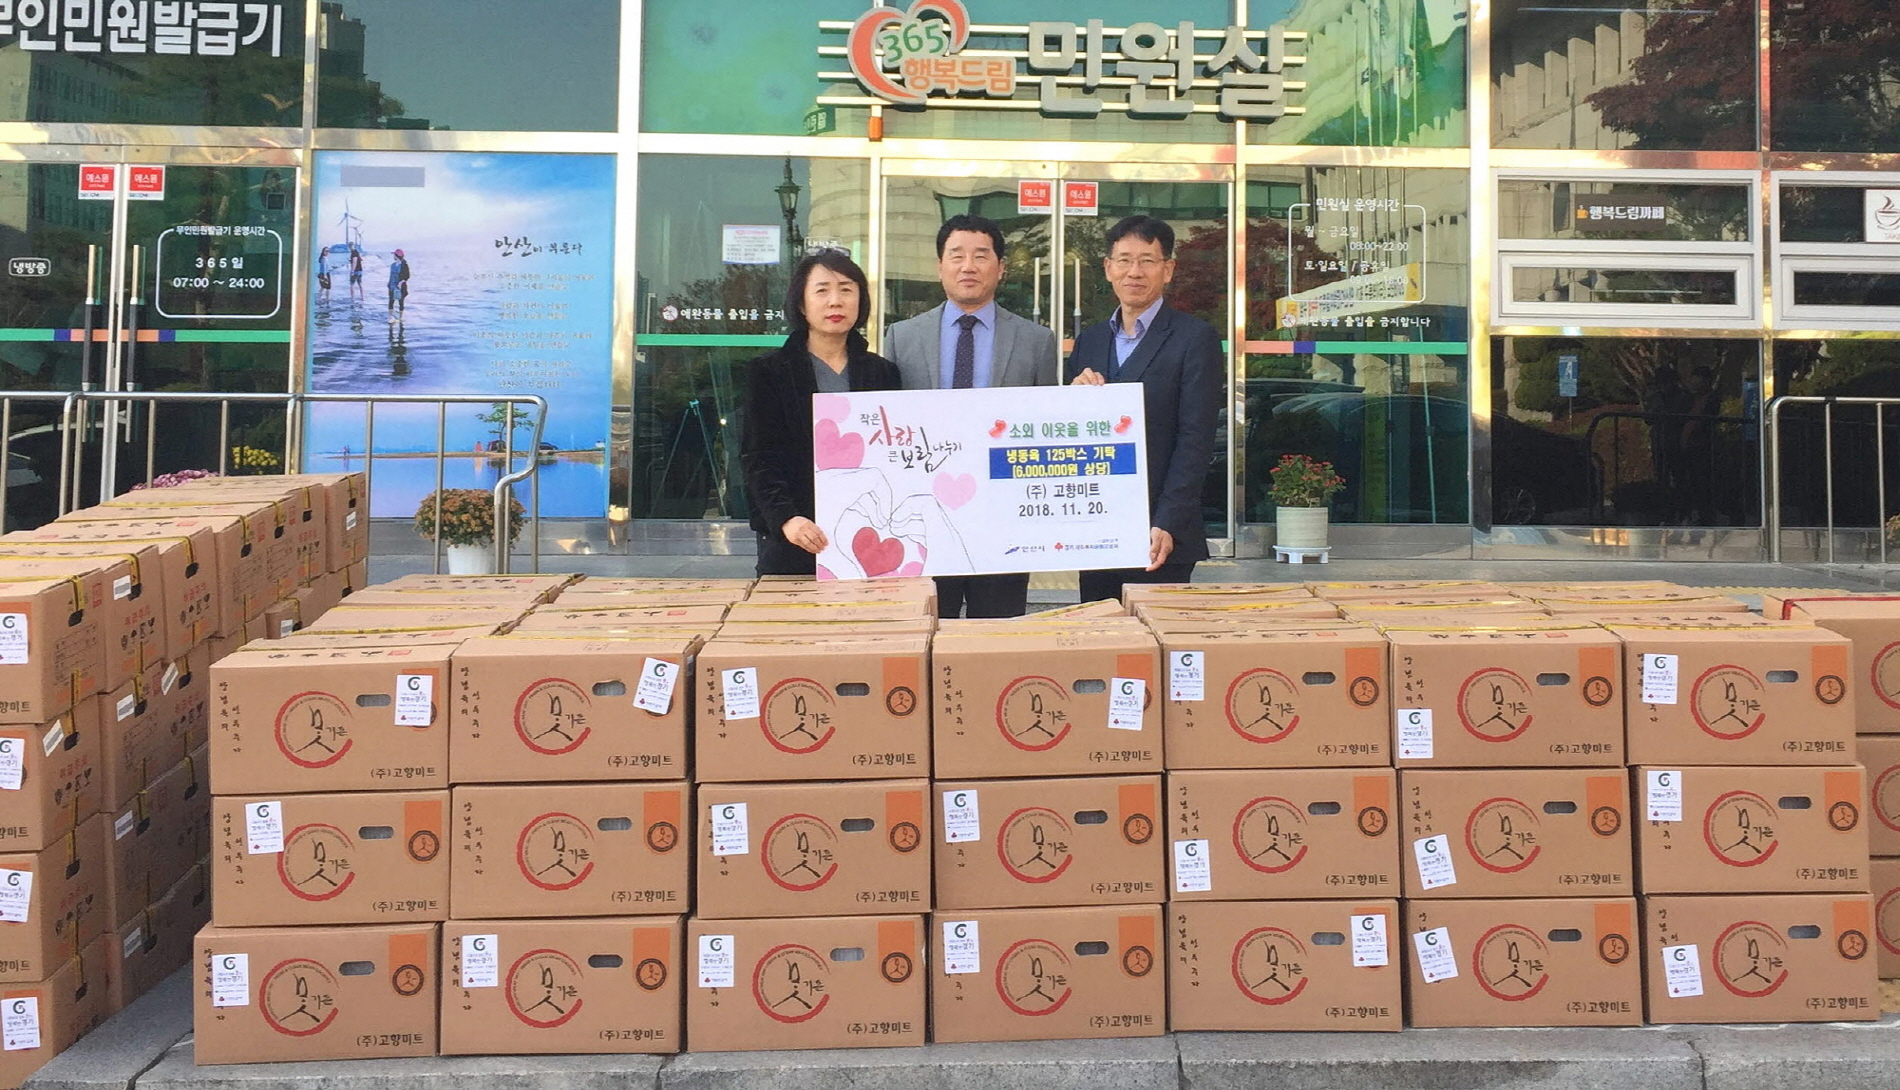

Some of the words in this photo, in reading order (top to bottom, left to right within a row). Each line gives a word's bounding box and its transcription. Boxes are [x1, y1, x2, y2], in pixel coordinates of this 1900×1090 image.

[881, 21, 946, 62] 365
[903, 57, 1012, 93] 행복드림
[1028, 19, 1284, 118] 민원실
[1316, 198, 1350, 211] 민원실
[1354, 199, 1399, 212] 운영시간
[1589, 205, 1665, 220] 행복드림까페
[234, 226, 265, 236] 운영시간
[1328, 226, 1359, 238] 금요일
[173, 277, 209, 288] 07:00
[229, 277, 265, 288] 24:00
[680, 308, 724, 321] 애완동물
[727, 308, 759, 320] 출입을
[1344, 316, 1375, 327] 출입을
[1379, 316, 1431, 327] 금지합니다
[860, 413, 881, 426] 작은
[869, 405, 916, 446] 사랑
[1009, 423, 1035, 439] 소외
[1041, 421, 1079, 438] 이웃을
[1086, 420, 1111, 437] 위한
[888, 450, 898, 462] 큰
[901, 426, 936, 473] 보람
[933, 440, 962, 456] 나누기
[1006, 449, 1040, 463] 냉동육
[1046, 448, 1088, 461] 125박스
[1093, 446, 1116, 460] 기탁
[1026, 483, 1047, 499] (주)
[1053, 483, 1100, 498] 고향미트
[1018, 504, 1054, 517] 2018.
[1062, 502, 1081, 515] 11.
[1088, 501, 1108, 514] 20.
